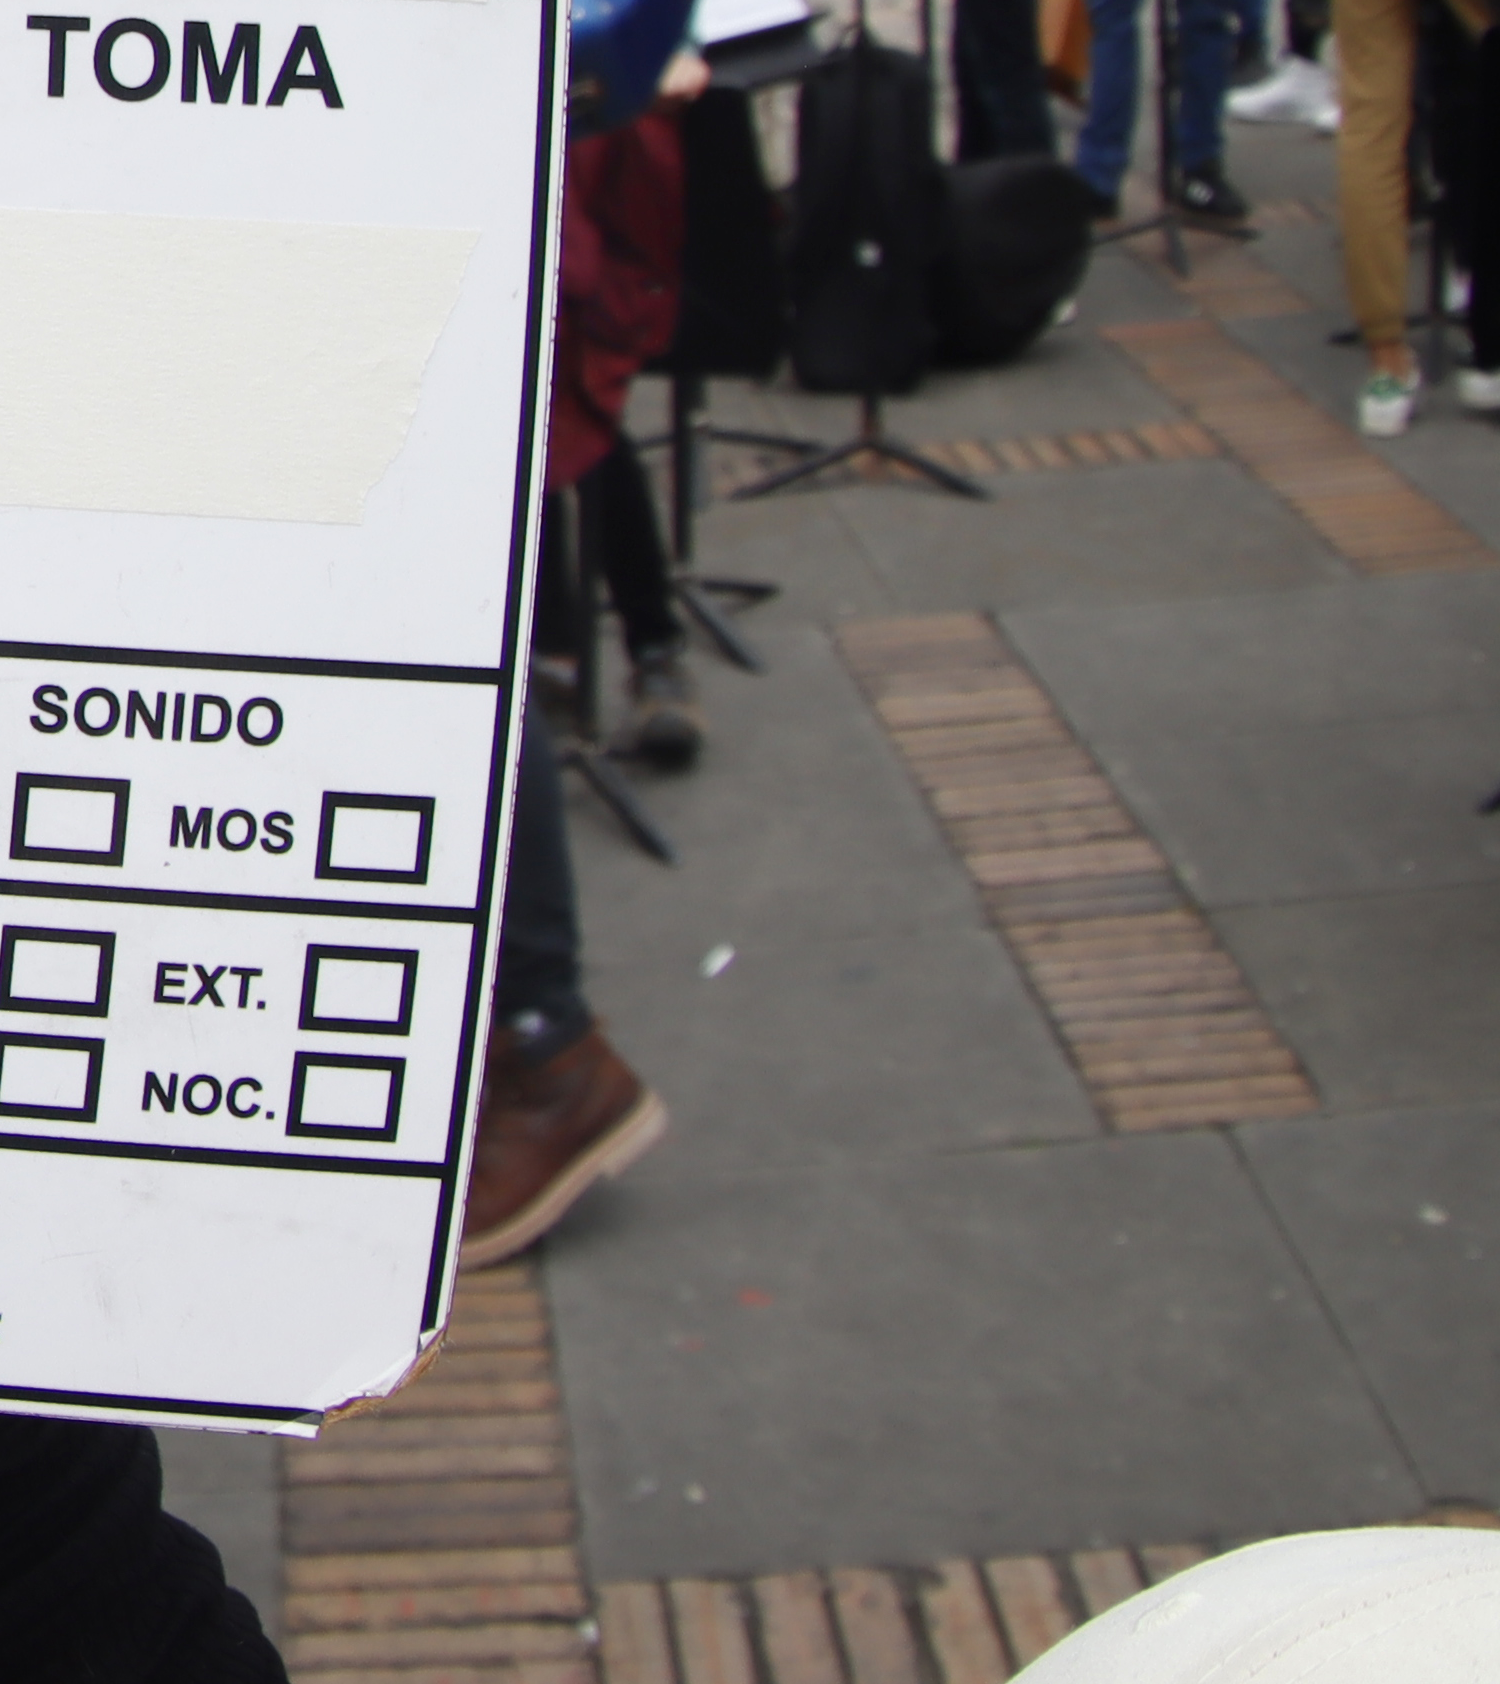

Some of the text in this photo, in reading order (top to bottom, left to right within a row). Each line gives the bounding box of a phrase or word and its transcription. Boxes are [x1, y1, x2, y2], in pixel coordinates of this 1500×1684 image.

[25, 14, 345, 110] TOMA
[28, 683, 285, 748] SONIDO
[168, 804, 295, 856] MOS
[152, 960, 267, 1011] EXT.
[140, 1070, 276, 1121] NOC.
